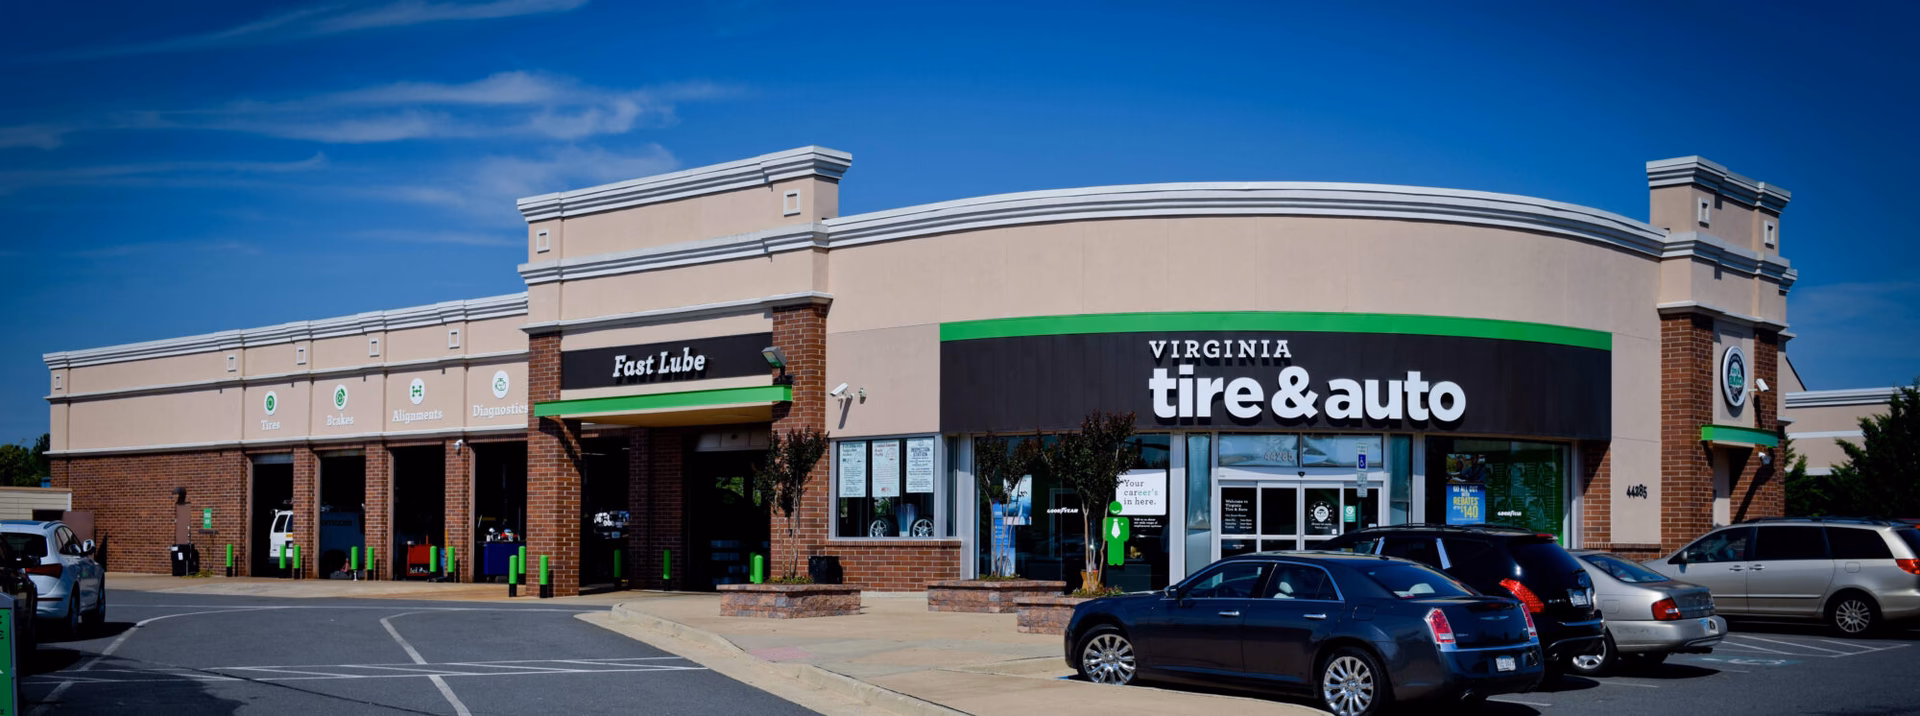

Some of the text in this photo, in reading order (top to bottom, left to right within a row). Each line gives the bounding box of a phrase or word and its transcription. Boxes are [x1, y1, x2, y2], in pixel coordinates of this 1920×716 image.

[1149, 340, 1292, 358] VIRGINIA
[612, 346, 706, 378] Fast Lube
[1149, 364, 1466, 422] tire & auto
[392, 408, 443, 424] Alignments
[472, 402, 529, 418] Diagnostics
[260, 419, 281, 431] Tires
[326, 413, 354, 427] Brakes
[1264, 451, 1295, 462] 44285
[1123, 479, 1145, 488] Your
[1123, 488, 1159, 497] career's
[1626, 484, 1648, 500] 44285
[1123, 497, 1157, 505] in here.
[1046, 506, 1079, 515] GOODYEAR
